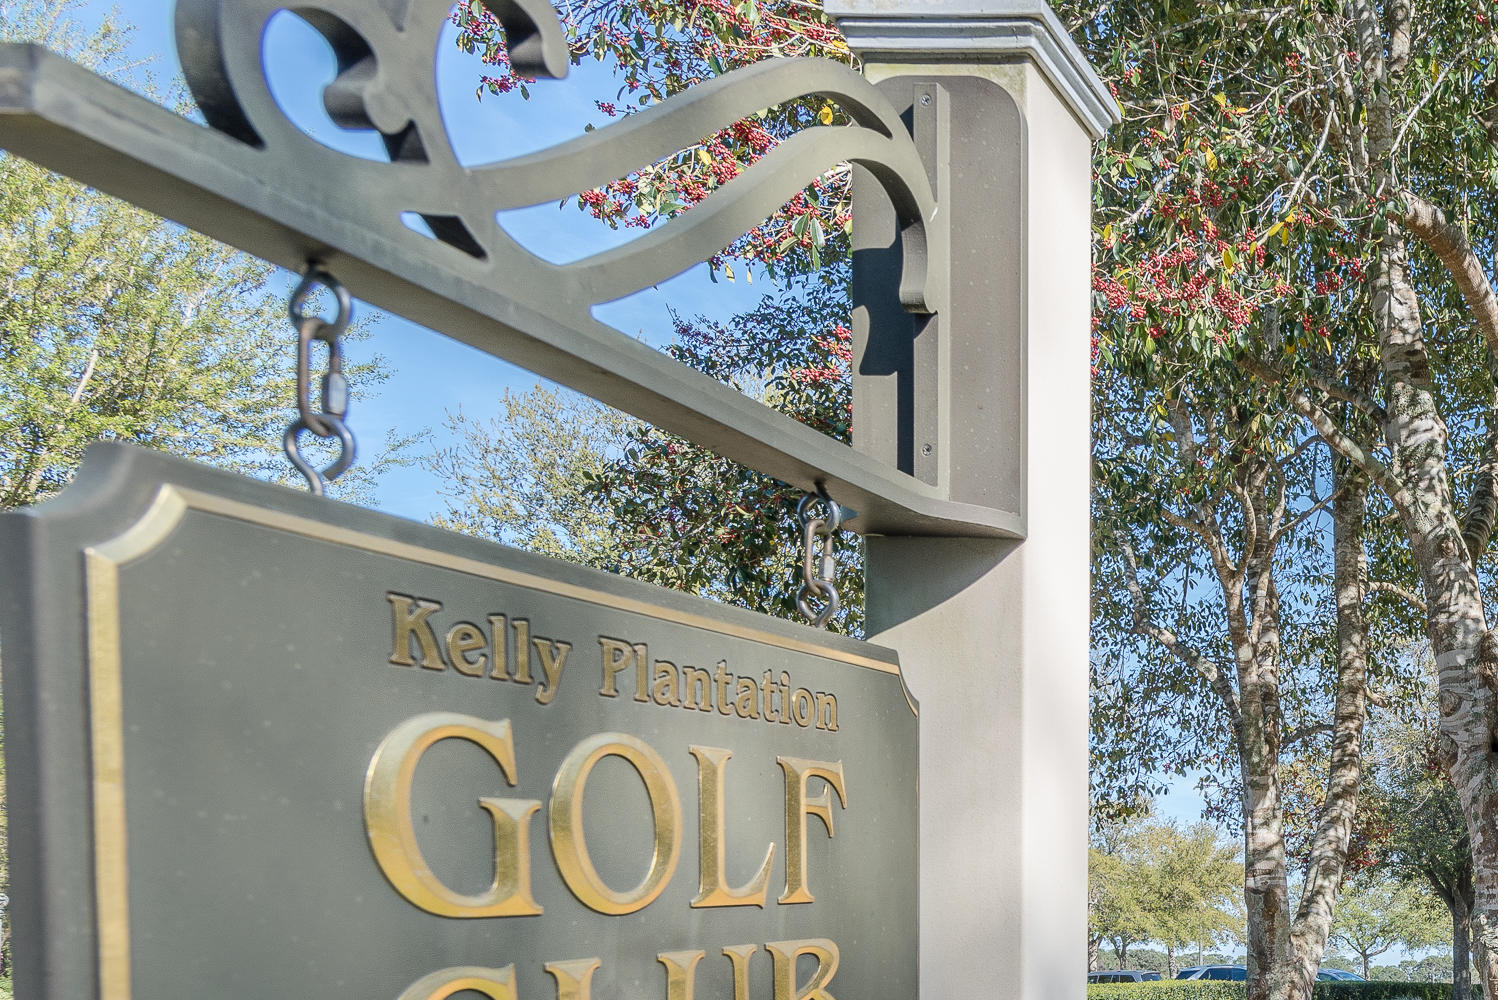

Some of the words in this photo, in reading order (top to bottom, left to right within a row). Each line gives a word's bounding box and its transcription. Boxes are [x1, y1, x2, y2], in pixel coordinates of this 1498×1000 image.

[386, 591, 571, 704] Kelly
[598, 636, 840, 732] Plantation
[363, 711, 847, 918] GOLF
